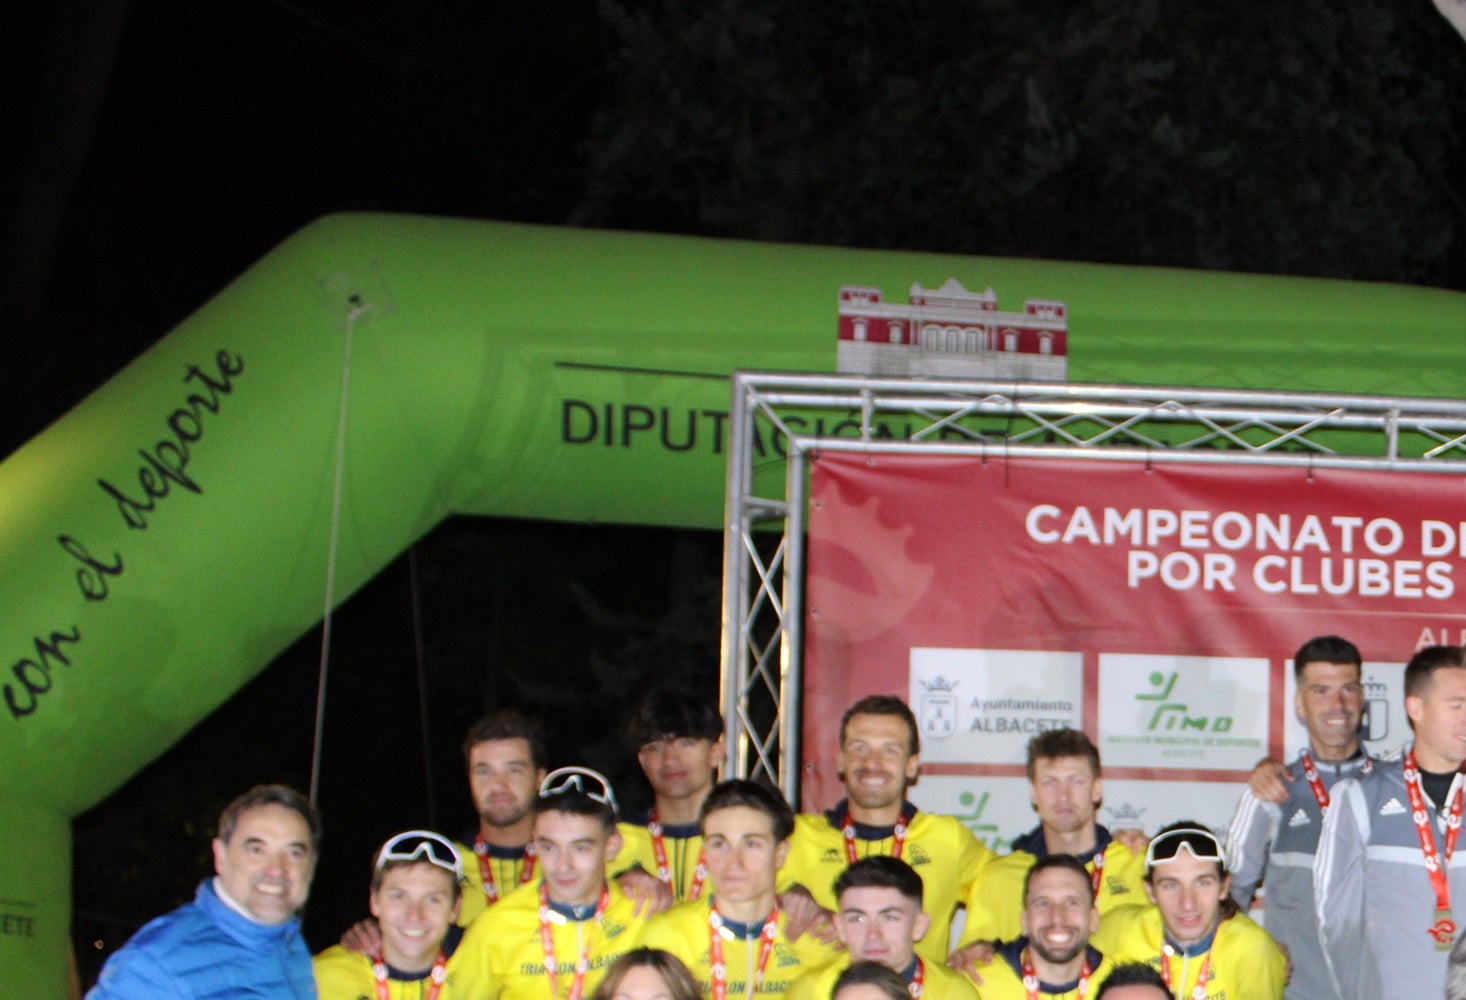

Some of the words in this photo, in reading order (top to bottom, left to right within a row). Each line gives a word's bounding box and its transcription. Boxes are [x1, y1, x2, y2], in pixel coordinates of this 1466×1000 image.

[2, 626, 81, 720] con
[57, 534, 124, 603] el
[98, 347, 243, 530] deporte
[1025, 504, 1403, 556] CAMPEONATO
[1127, 551, 1236, 592] POR
[1252, 555, 1454, 599] CLUBES
[970, 697, 1073, 712] Ayuntamiento
[970, 717, 1073, 734] ALBACETE
